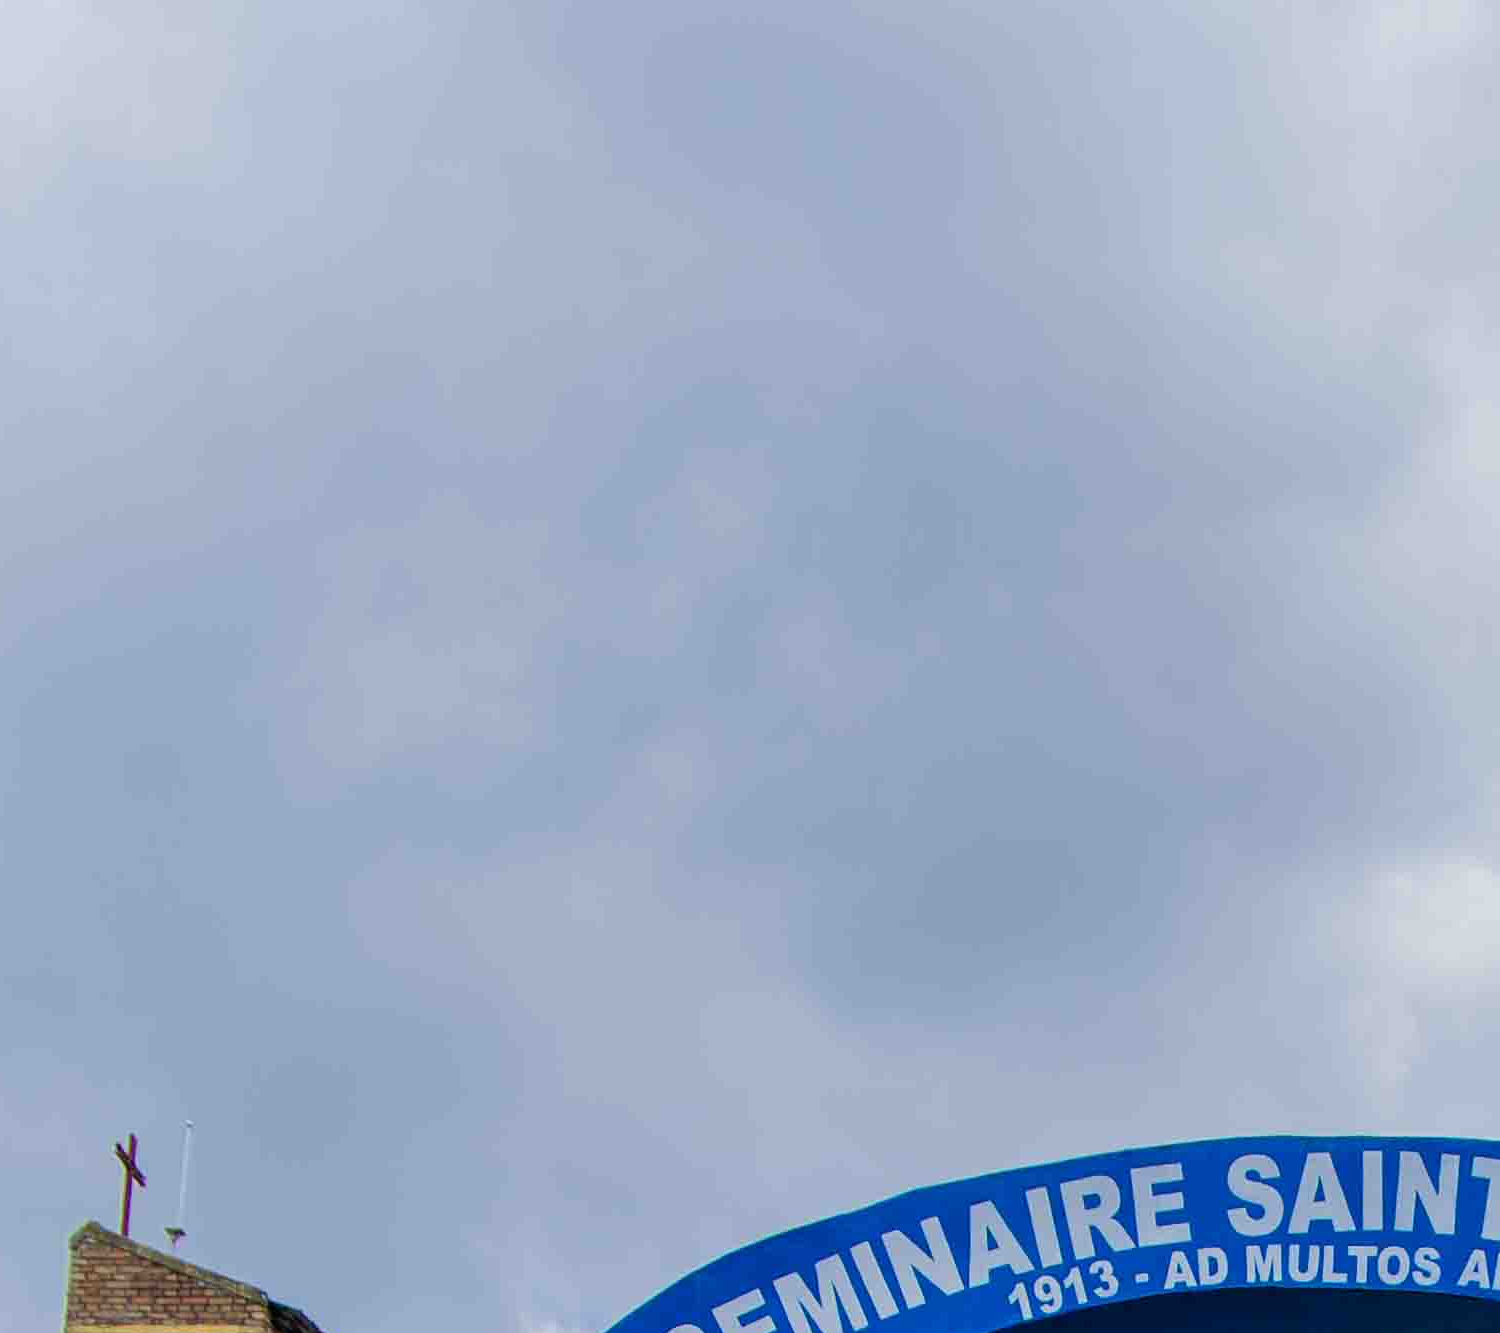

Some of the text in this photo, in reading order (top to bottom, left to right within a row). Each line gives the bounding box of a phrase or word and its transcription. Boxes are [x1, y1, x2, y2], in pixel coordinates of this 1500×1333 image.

[1008, 1260, 1120, 1321] 1913
[1163, 1246, 1229, 1290] AD
[1245, 1243, 1442, 1285] MULTOS
